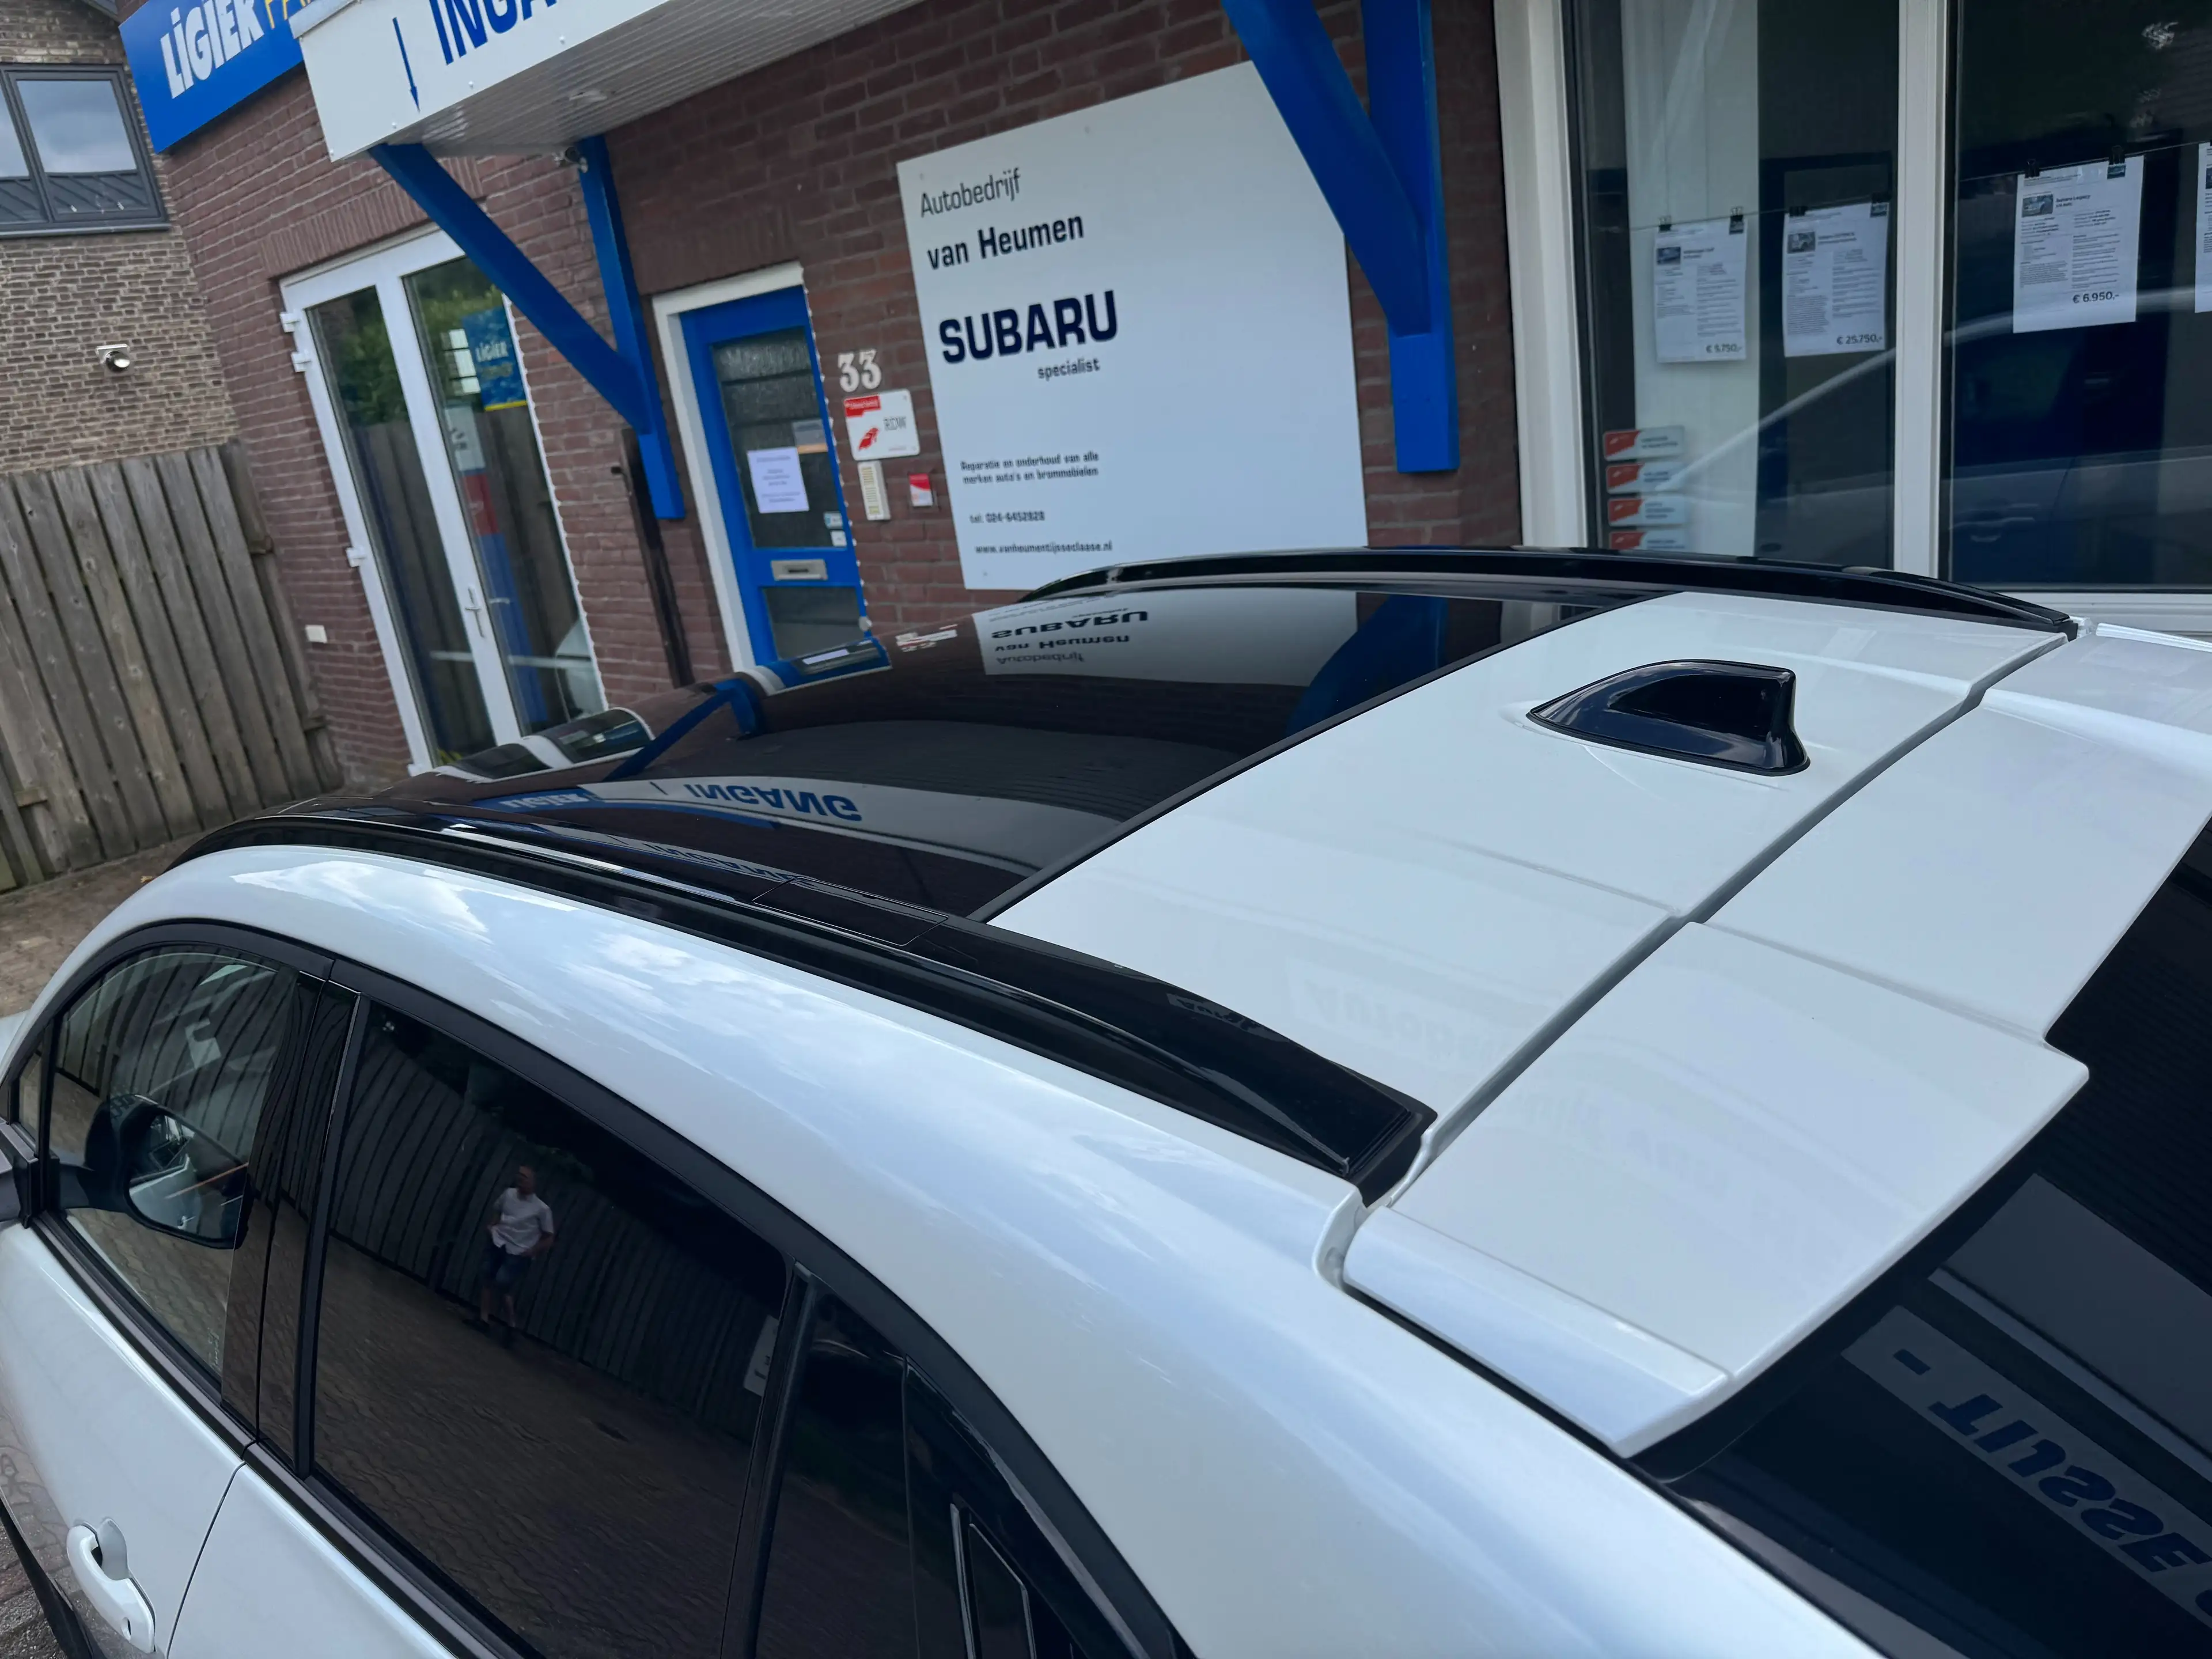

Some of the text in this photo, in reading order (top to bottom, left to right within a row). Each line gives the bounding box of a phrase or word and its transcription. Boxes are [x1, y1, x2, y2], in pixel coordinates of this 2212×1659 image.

[921, 167, 1020, 218] Autobedrijf
[927, 215, 1085, 270] van Heumen
[939, 289, 1118, 364] SUBARU
[838, 349, 881, 392] 33
[1037, 358, 1101, 381] specialist
